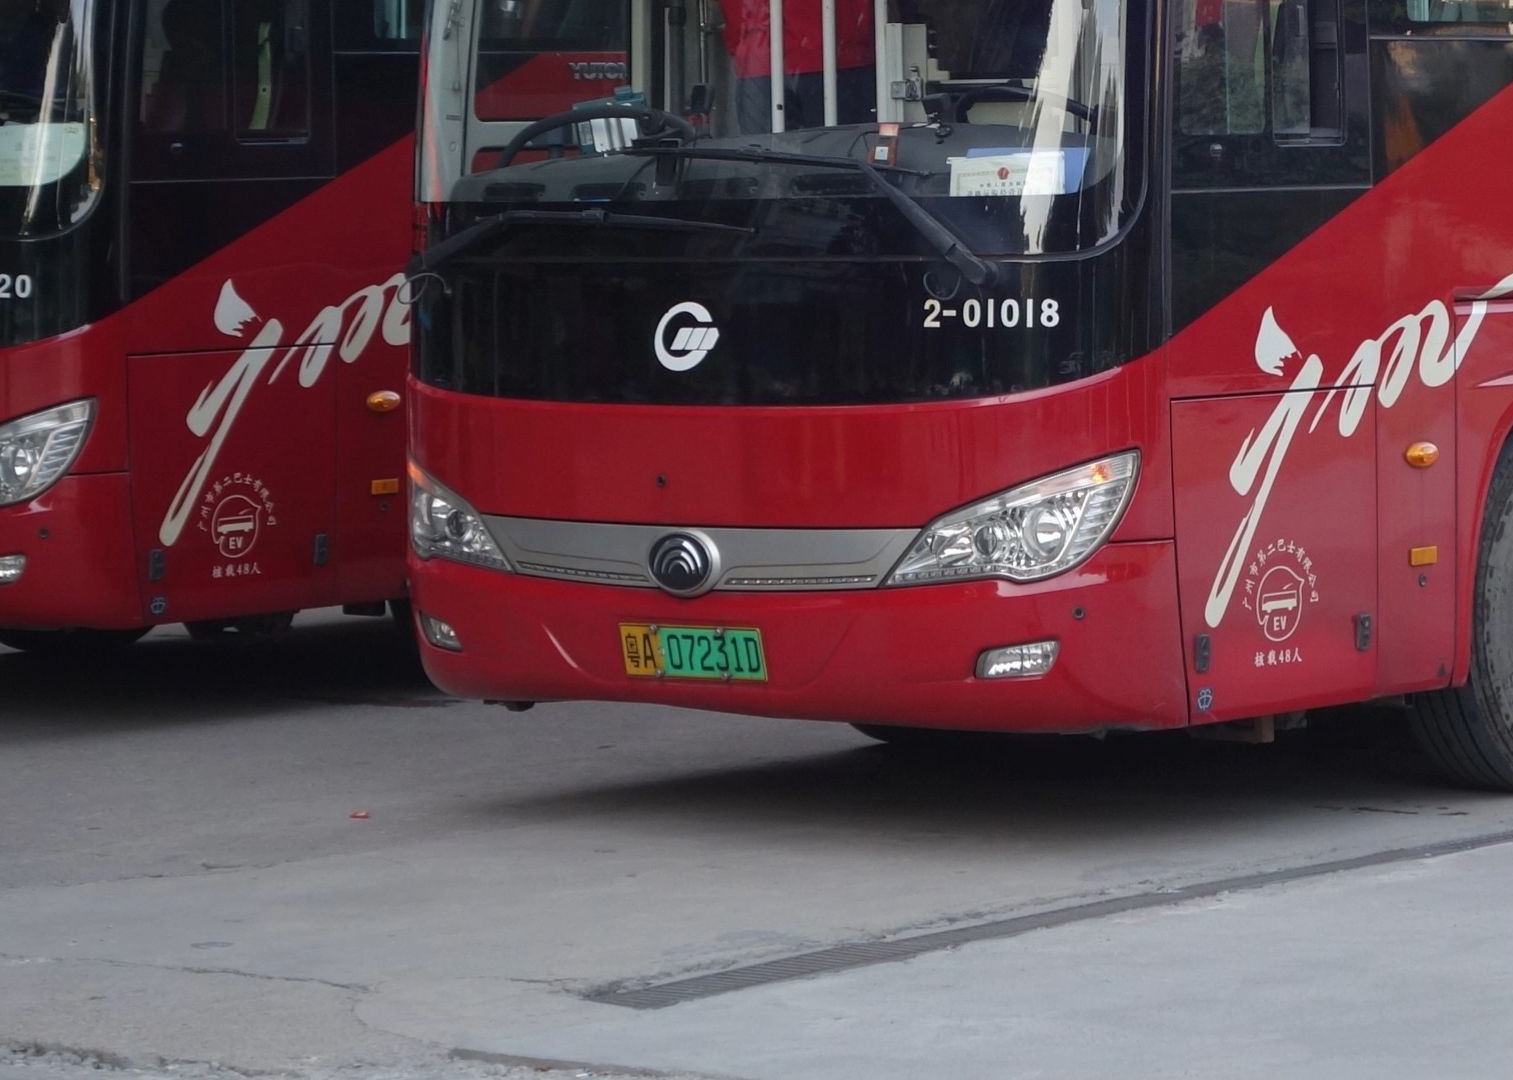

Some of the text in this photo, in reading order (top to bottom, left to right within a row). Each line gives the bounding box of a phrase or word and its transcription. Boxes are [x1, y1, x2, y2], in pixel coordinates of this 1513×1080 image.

[0, 273, 32, 299] 20
[923, 298, 1060, 328] 2-01018
[229, 536, 243, 550] EV
[1273, 615, 1287, 631] EV
